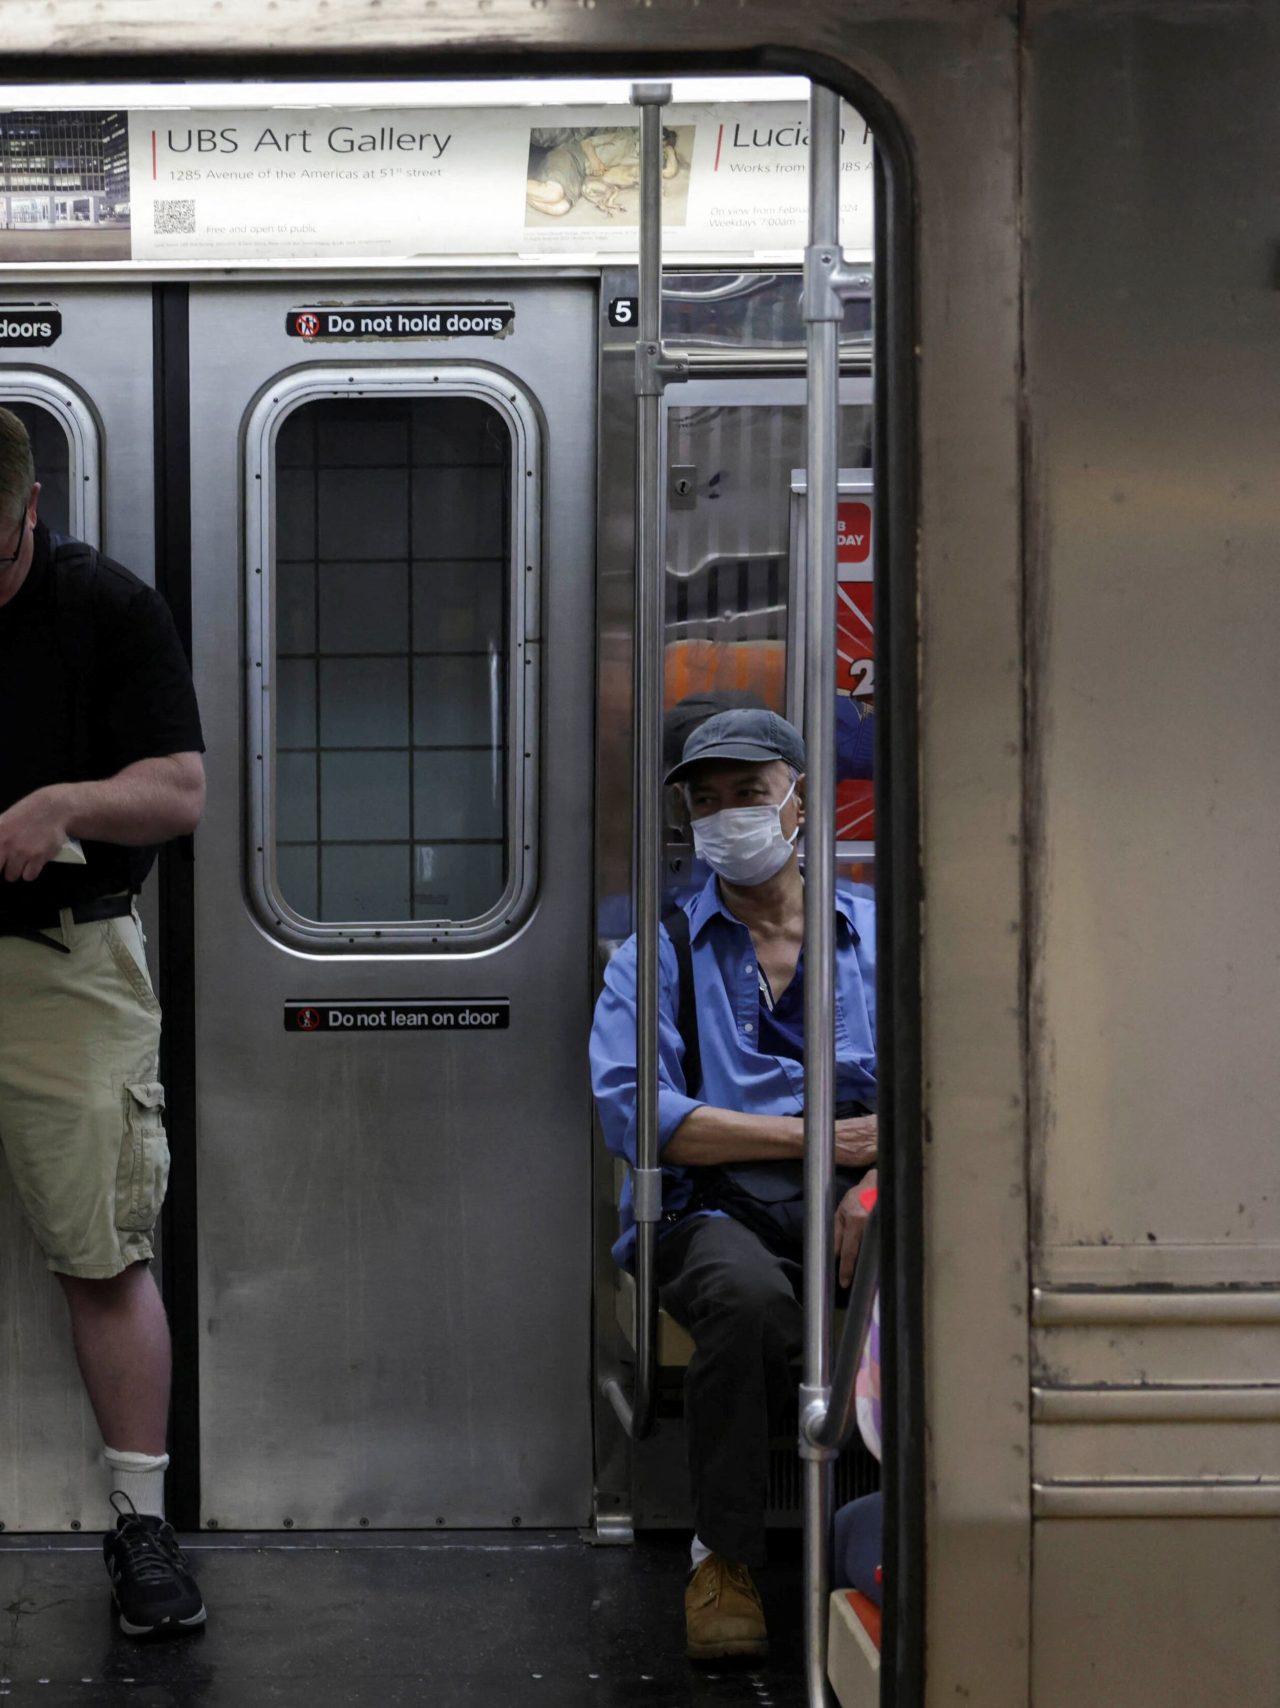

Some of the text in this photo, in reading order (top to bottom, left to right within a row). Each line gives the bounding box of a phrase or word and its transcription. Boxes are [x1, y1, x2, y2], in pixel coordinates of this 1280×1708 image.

[167, 126, 452, 159] UBS Art Gallery
[169, 170, 202, 181] 1285
[206, 169, 254, 180] Avenue
[258, 168, 272, 179] of
[276, 168, 297, 179] the
[300, 168, 359, 180] Americas
[362, 169, 375, 179] at
[405, 168, 442, 178] street
[729, 163, 771, 173] Works
[775, 162, 805, 173] from
[614, 300, 632, 323] 5
[327, 313, 503, 333] Do not hold doors
[328, 1008, 500, 1027] Do not lean on door
